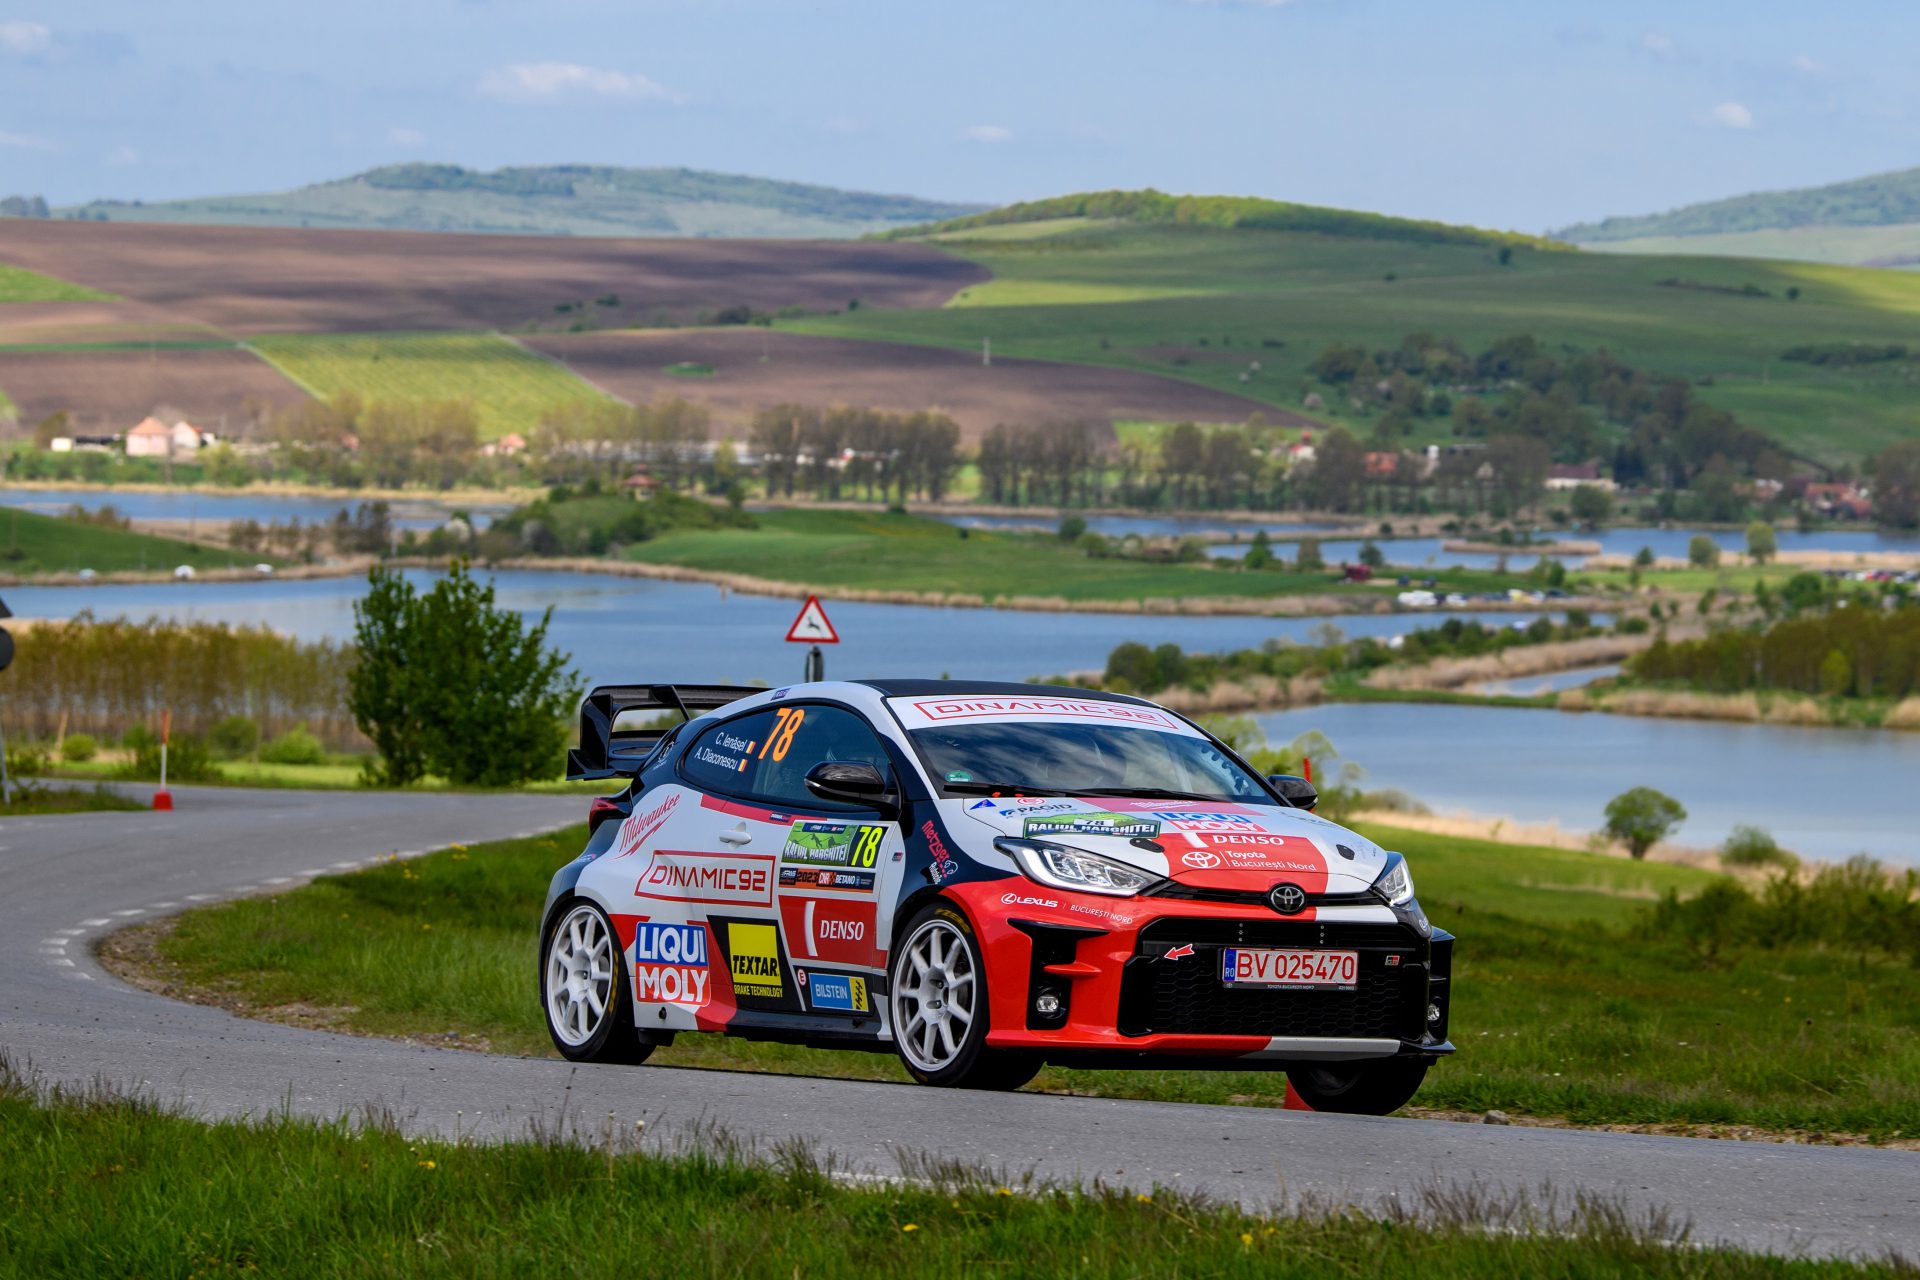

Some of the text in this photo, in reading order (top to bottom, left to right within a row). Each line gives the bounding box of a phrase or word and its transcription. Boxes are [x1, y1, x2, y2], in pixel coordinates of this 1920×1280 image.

[934, 701, 1159, 720] DINAMIC92
[715, 732, 722, 745] C.
[758, 707, 805, 762] 78
[702, 748, 738, 770] Diaconescu
[619, 794, 680, 852] Milwaukee
[1160, 812, 1246, 822] LIQUI
[1174, 821, 1259, 831] MOLY
[1029, 823, 1076, 832] RALIUL
[1082, 824, 1155, 833] HARGHITEI
[784, 840, 808, 859] RALIUL
[851, 826, 883, 868] 78
[921, 820, 950, 862] Metzger
[1212, 835, 1284, 846] DENSO
[1227, 851, 1267, 860] Toyota
[1287, 861, 1316, 871] Nord
[648, 865, 767, 892] DINAMIC92
[835, 874, 856, 885] BETANO
[1017, 898, 1058, 908] LEXUS
[1110, 912, 1133, 925] NORD
[820, 920, 865, 941] DENSO
[639, 926, 706, 964] LIQUI
[733, 955, 779, 977] TEXTAR
[1225, 953, 1355, 980] RO BV 025470
[638, 966, 709, 1003] MOLY
[734, 985, 783, 998] BRAKE TECHNOLOGY
[815, 984, 848, 999] BILSTEIN
